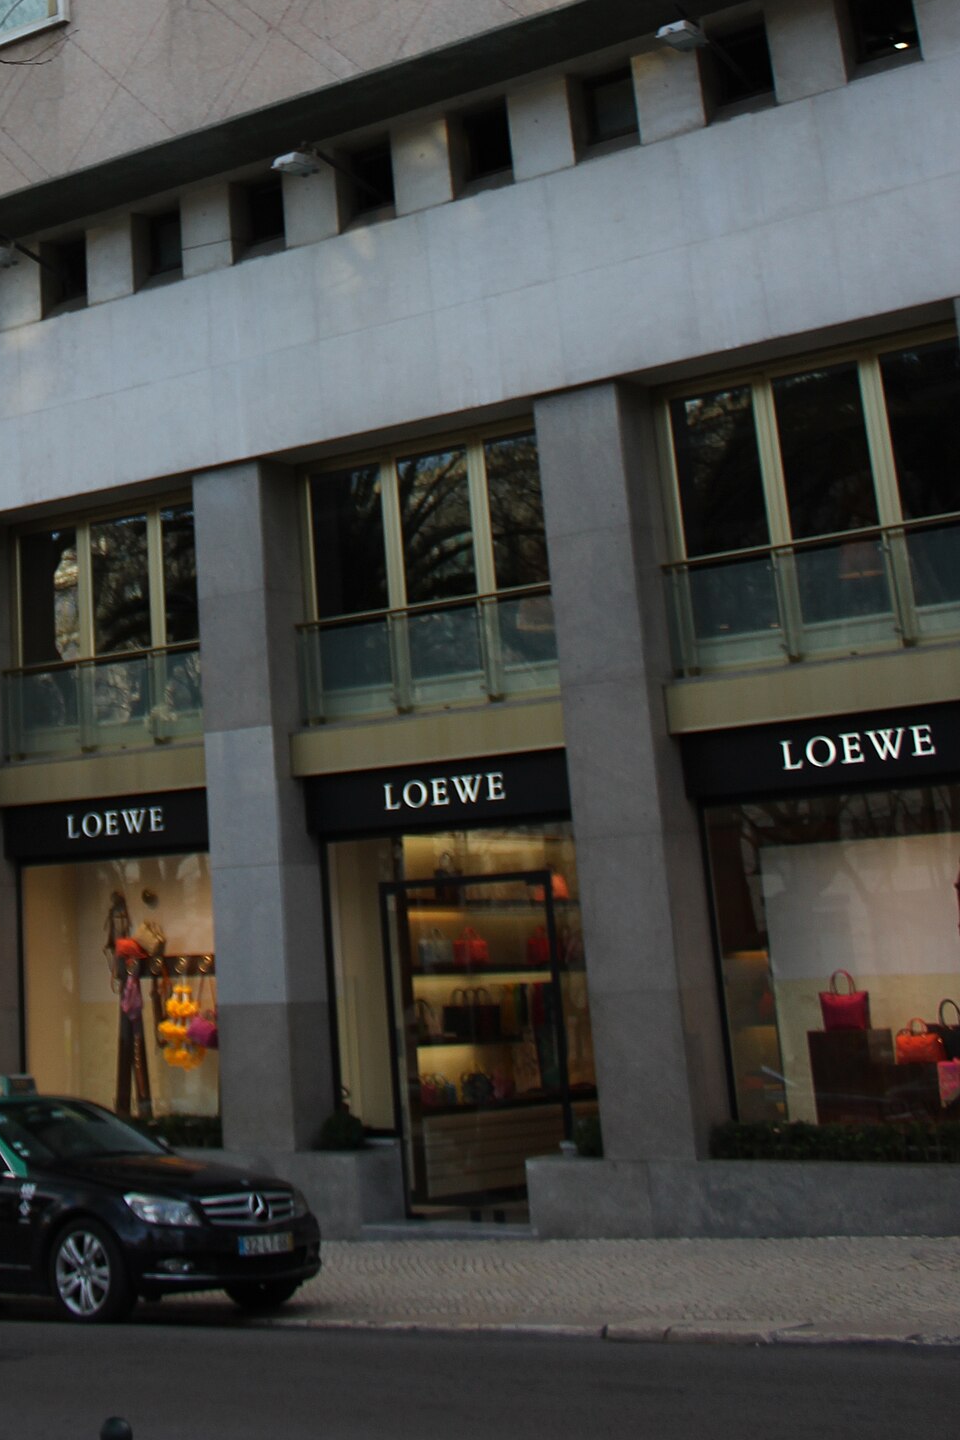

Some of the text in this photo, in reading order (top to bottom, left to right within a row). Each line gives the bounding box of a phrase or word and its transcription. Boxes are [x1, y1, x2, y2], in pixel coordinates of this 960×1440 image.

[779, 724, 936, 770] LOEWE
[383, 771, 506, 810] LOEWE
[66, 806, 165, 839] LOEWE
